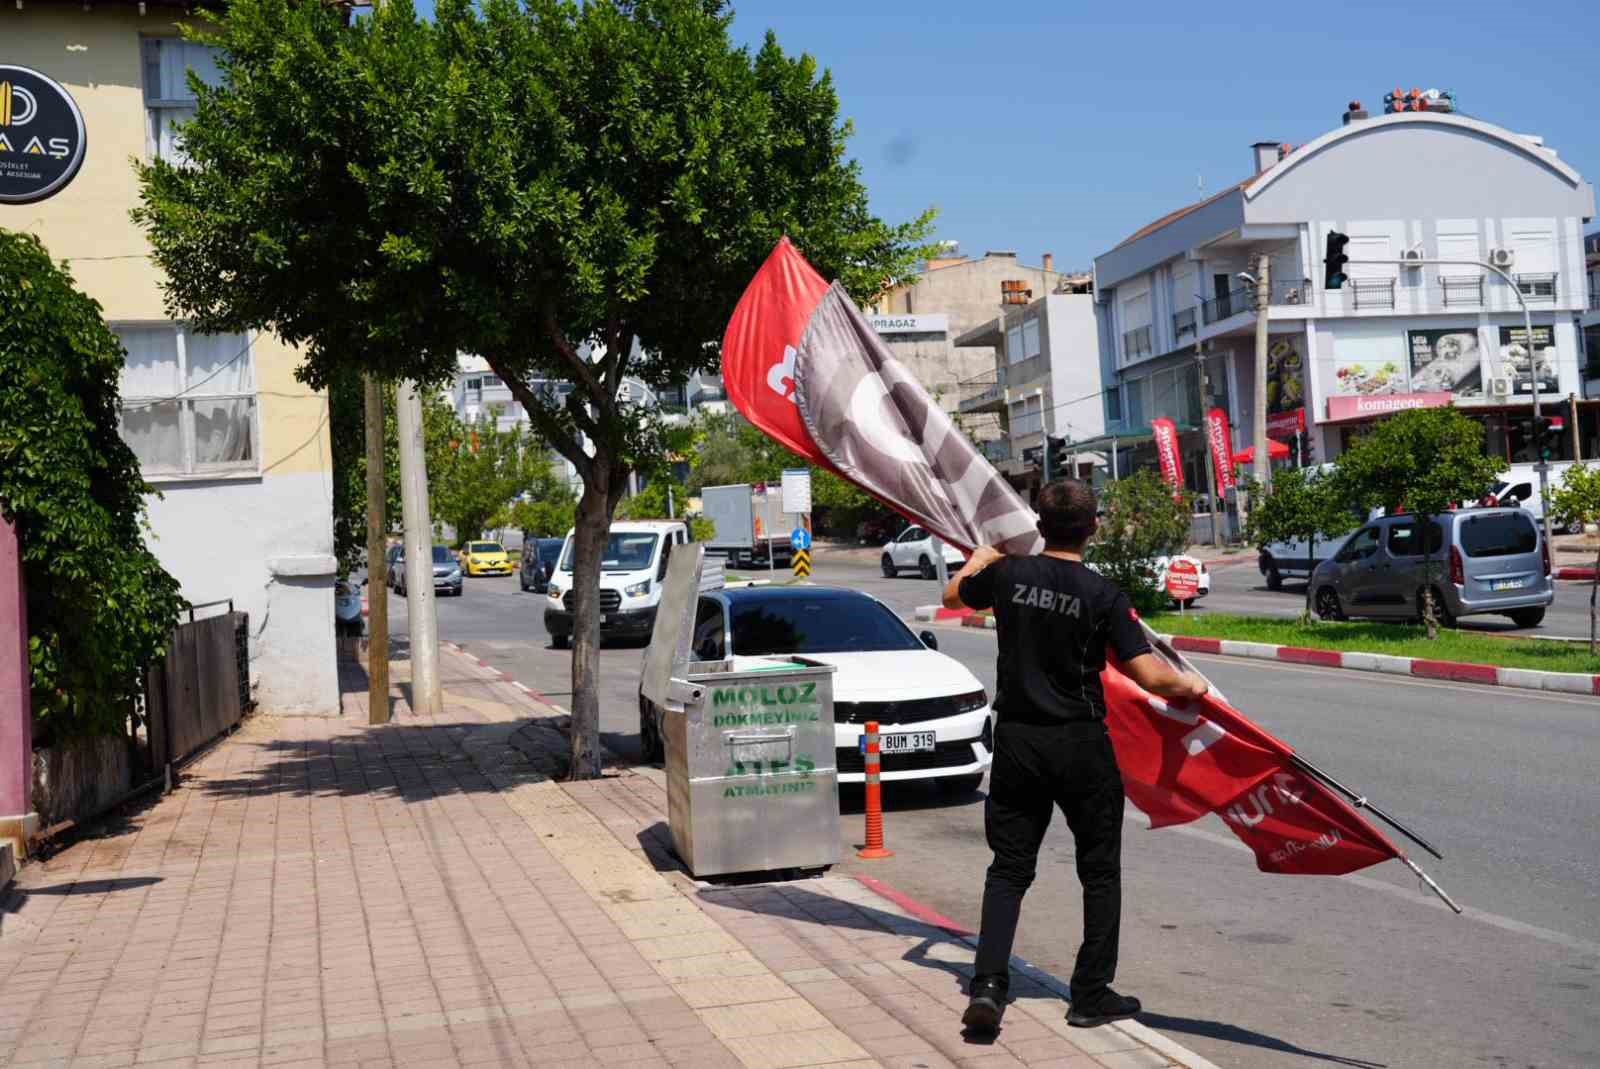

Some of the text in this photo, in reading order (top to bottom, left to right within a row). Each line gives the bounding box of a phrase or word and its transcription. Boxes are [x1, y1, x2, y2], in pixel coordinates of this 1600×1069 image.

[1012, 583, 1081, 619] ZABITA
[713, 682, 817, 706] MOLOZ
[886, 734, 933, 749] BUM 319
